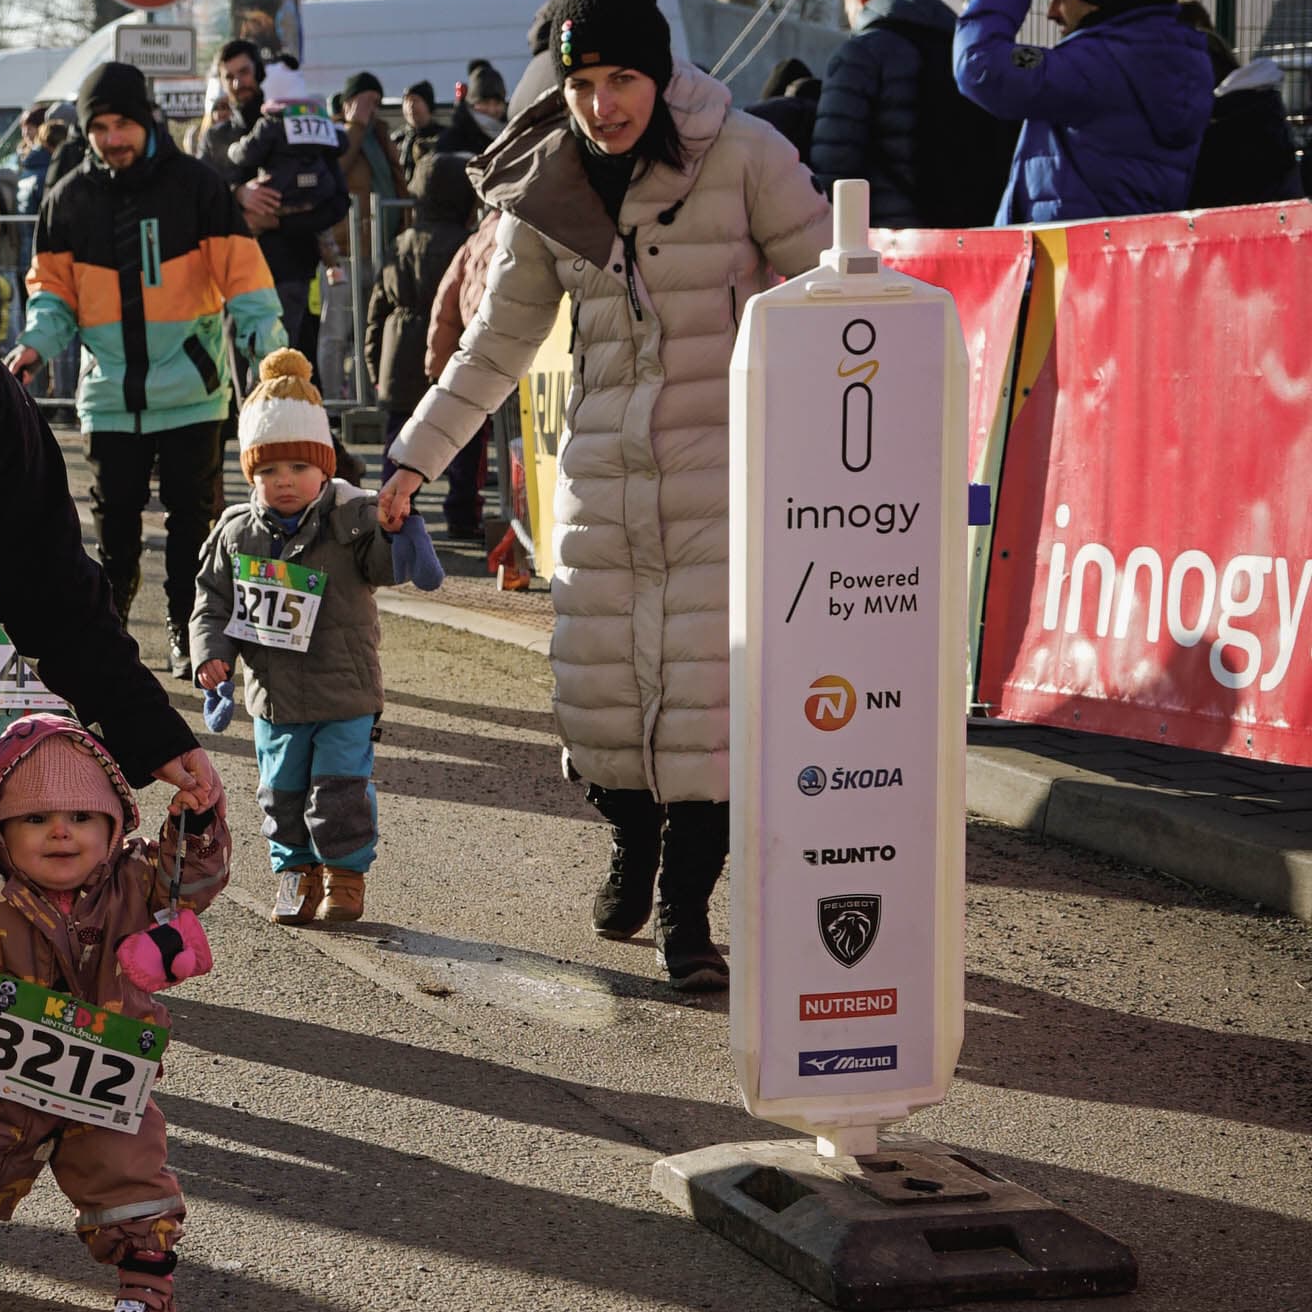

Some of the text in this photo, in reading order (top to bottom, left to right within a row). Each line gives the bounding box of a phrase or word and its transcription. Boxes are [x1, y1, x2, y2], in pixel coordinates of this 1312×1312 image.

[291, 119, 329, 136] 3171
[787, 497, 920, 534] innogy
[829, 567, 919, 590] Powered
[237, 584, 306, 630] 3215
[829, 594, 917, 620] by MVM
[866, 690, 901, 710] NN
[830, 767, 903, 790] ŠKODA
[821, 845, 896, 865] RUNTO
[824, 900, 875, 910] PEUGEOT
[805, 995, 893, 1015] NUTREND
